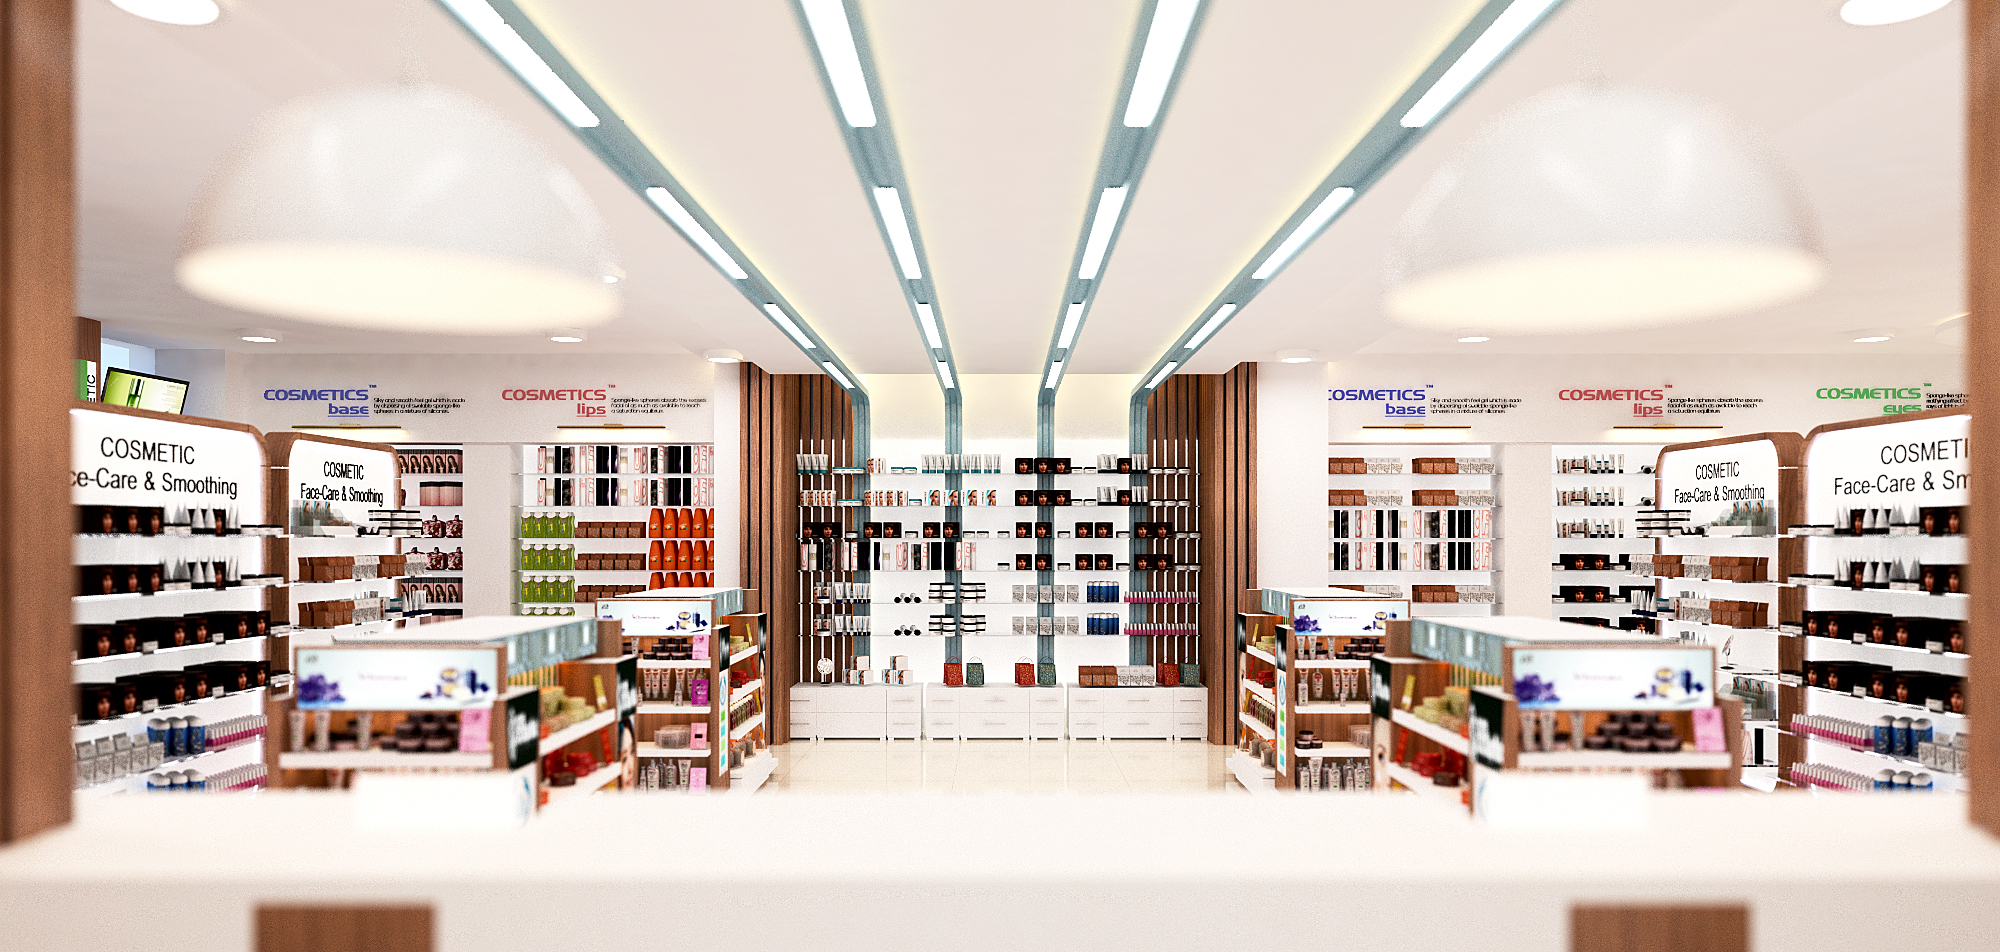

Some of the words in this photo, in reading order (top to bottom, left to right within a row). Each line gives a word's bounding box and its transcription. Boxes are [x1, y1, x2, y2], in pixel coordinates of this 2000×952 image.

[87, 374, 97, 403] ETIC
[263, 389, 369, 401] COSMETICS
[501, 389, 607, 401] COSMETICS
[1558, 389, 1664, 401] COSMETICS
[1816, 388, 1922, 400] COSMETICS
[328, 403, 369, 415] base
[577, 403, 607, 417] lips
[1385, 403, 1426, 415] base
[1633, 403, 1664, 417] lips
[1883, 404, 1922, 415] eyes
[100, 437, 195, 465] COSMETIC
[1881, 438, 1968, 465] COSMETI
[323, 461, 364, 480] COSMETIC
[1695, 461, 1740, 480] COSMETIC
[72, 467, 137, 490] e-Care
[144, 471, 155, 491] &
[162, 472, 237, 500] Smoothing
[1834, 474, 1916, 495] Face-Care
[1922, 471, 1935, 491] &
[300, 483, 340, 501] Face-Care
[341, 486, 347, 501] &
[349, 486, 384, 507] Smoothing
[1674, 487, 1712, 503] Face-Care
[1713, 485, 1720, 501] &
[1722, 483, 1765, 501] Smoothing
